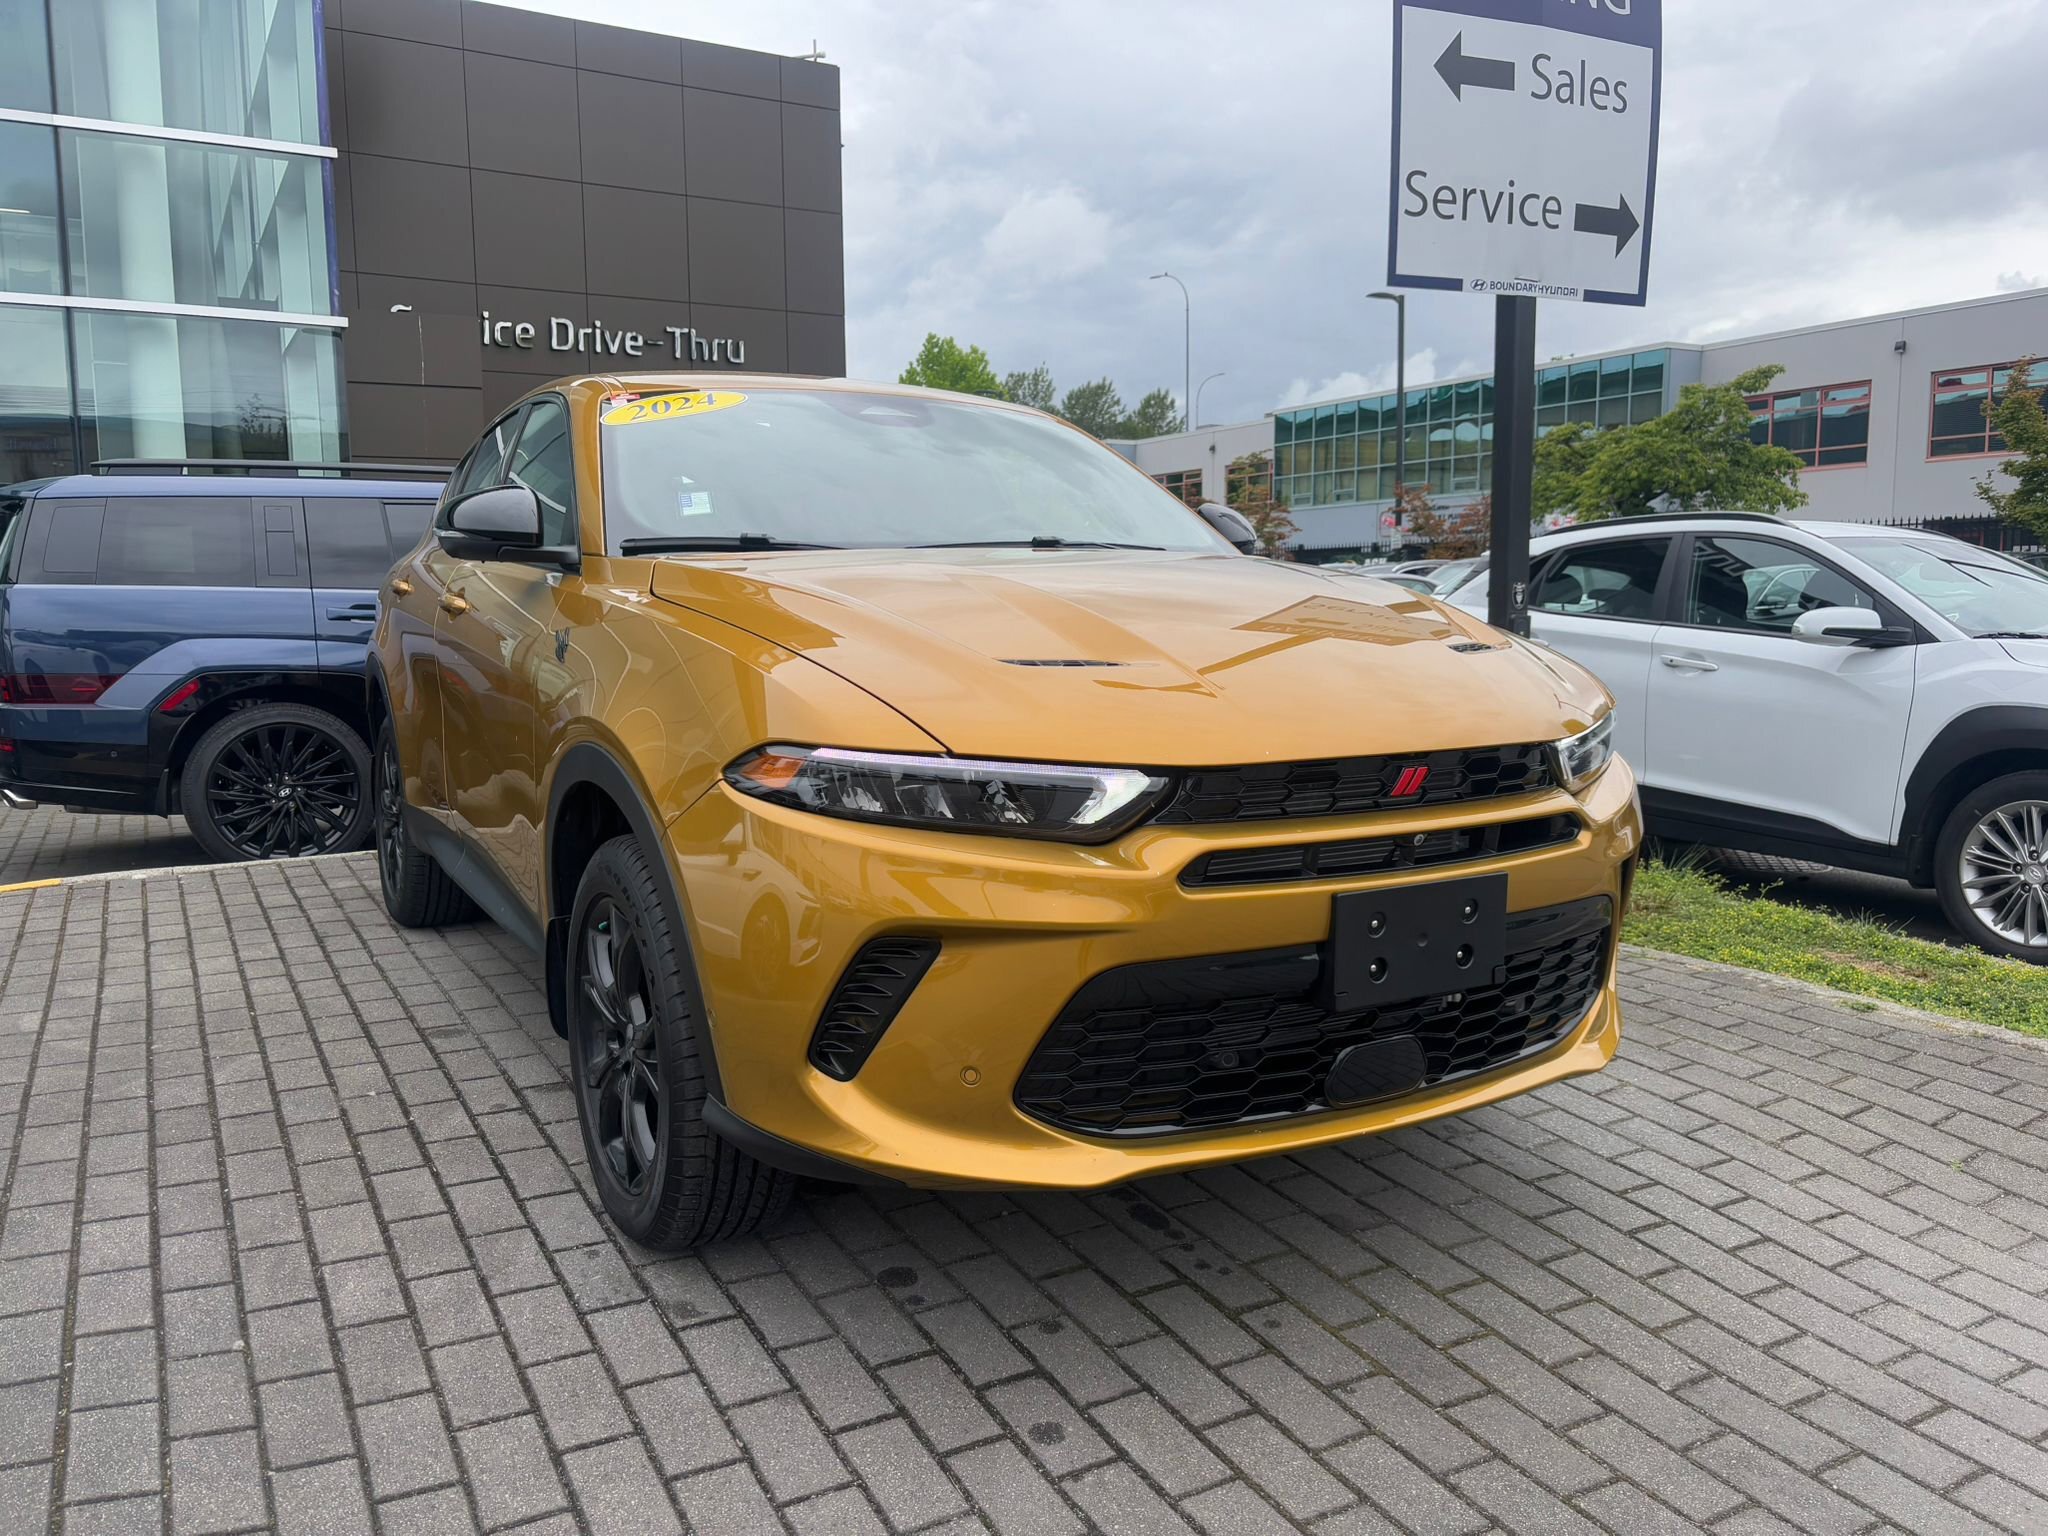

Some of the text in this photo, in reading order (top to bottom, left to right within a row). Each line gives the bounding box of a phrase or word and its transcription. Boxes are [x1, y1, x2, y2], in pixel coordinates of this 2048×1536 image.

[1530, 53, 1628, 114] Sales
[1403, 169, 1562, 230] Service
[549, 316, 746, 364] Drive-Thru
[627, 393, 717, 421] 2024
